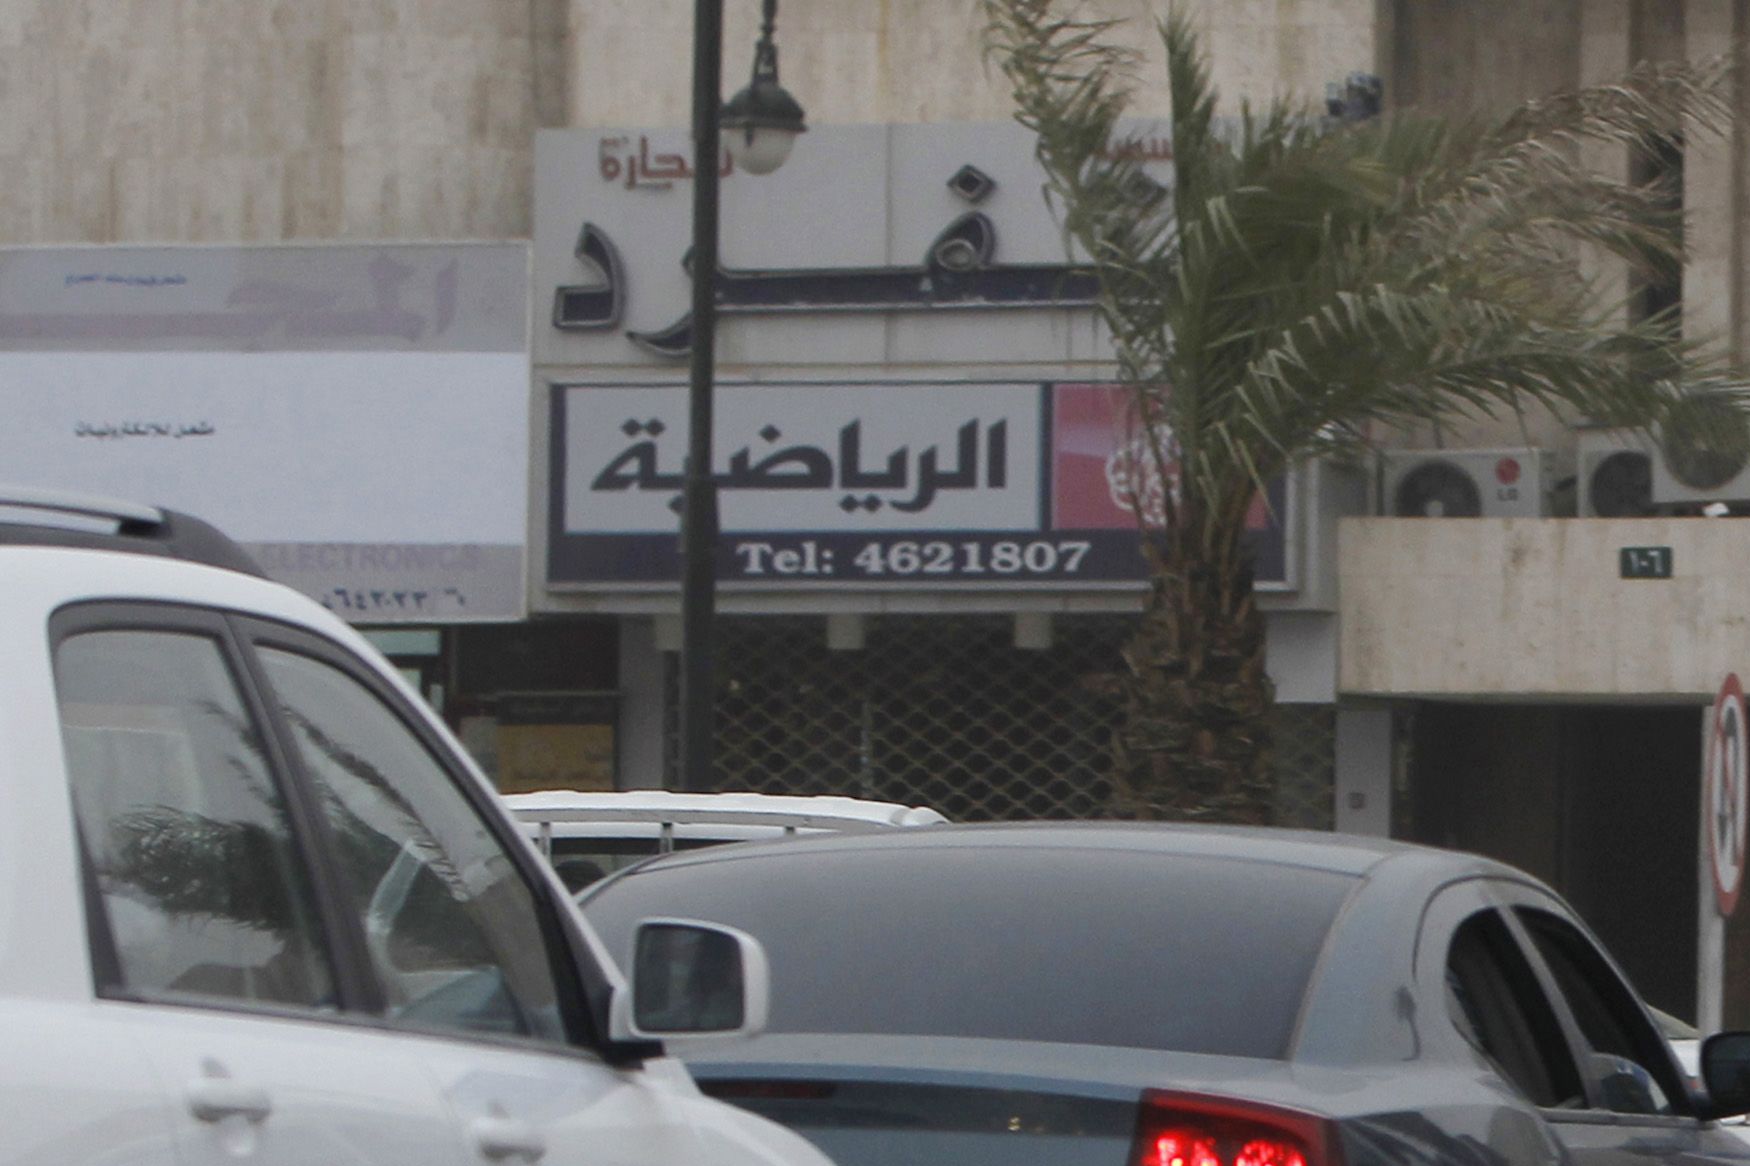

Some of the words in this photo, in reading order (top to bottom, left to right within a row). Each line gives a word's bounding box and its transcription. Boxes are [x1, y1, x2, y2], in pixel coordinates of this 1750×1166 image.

[590, 417, 1006, 514] الرياضية
[737, 542, 834, 574] Tel:
[853, 541, 1093, 574] 4621807
